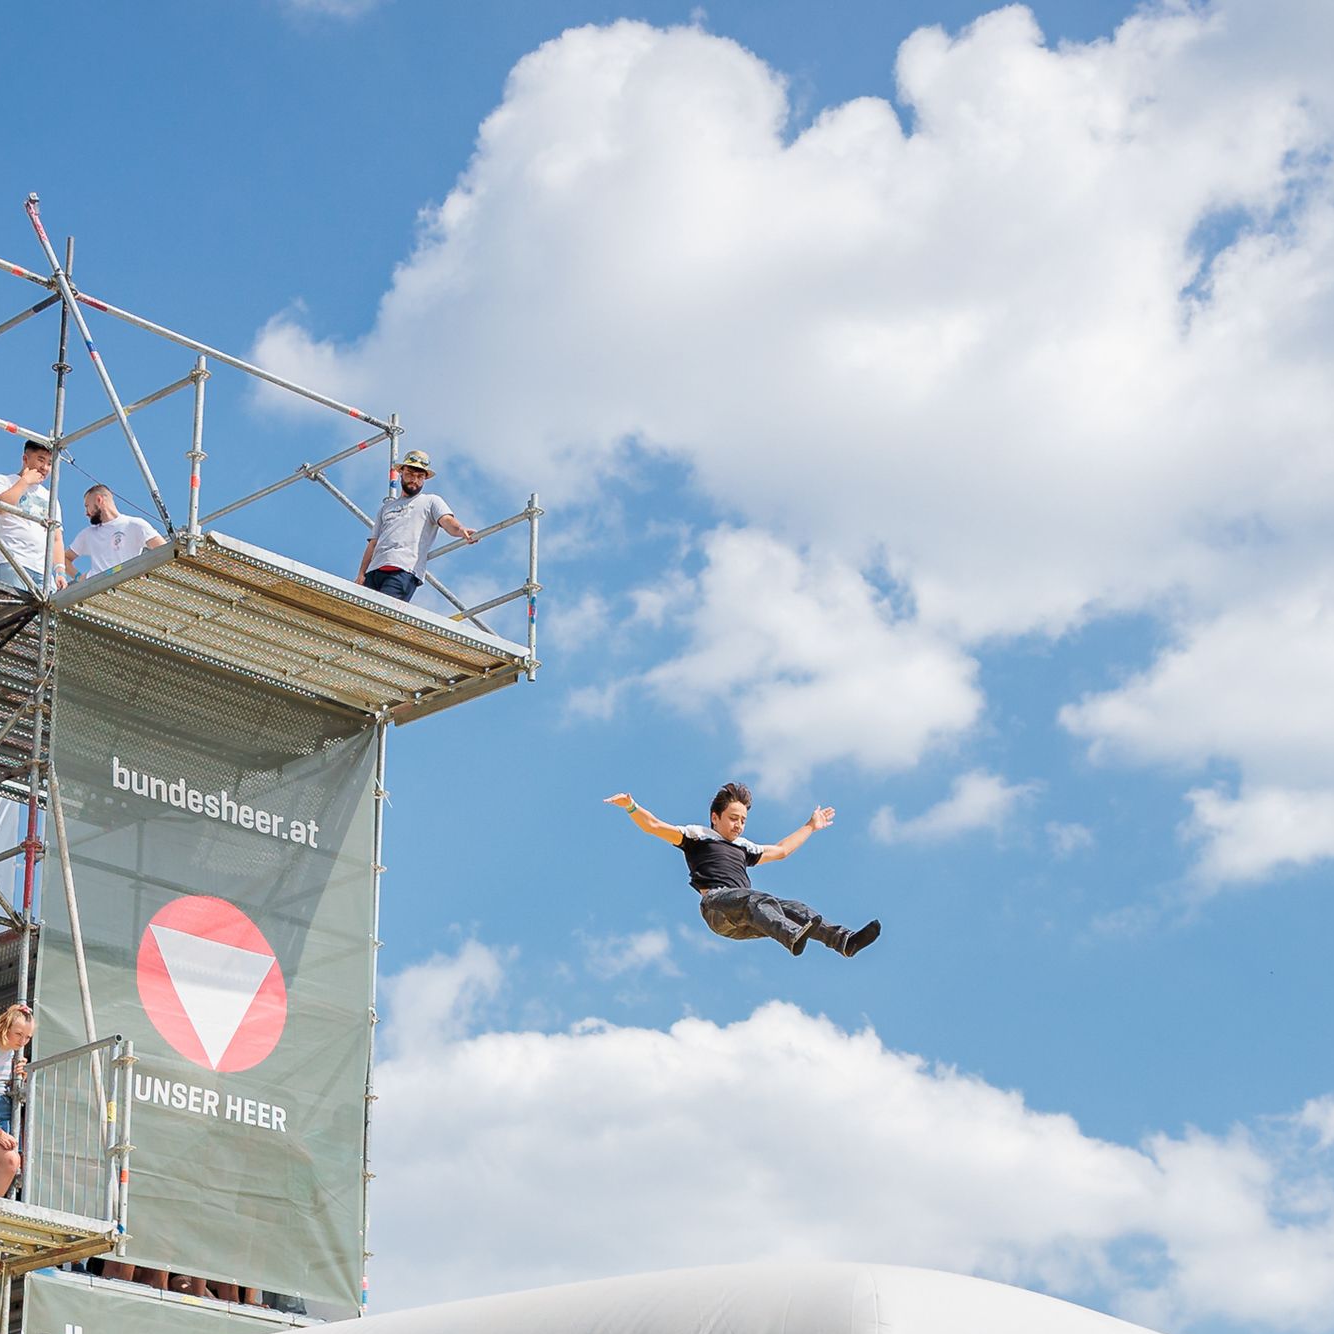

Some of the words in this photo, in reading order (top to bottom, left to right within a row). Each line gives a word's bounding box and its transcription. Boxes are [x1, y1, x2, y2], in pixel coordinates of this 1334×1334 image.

[112, 756, 320, 849] bundesheer.at
[134, 1074, 220, 1118] UNSER
[225, 1094, 287, 1133] HEER
